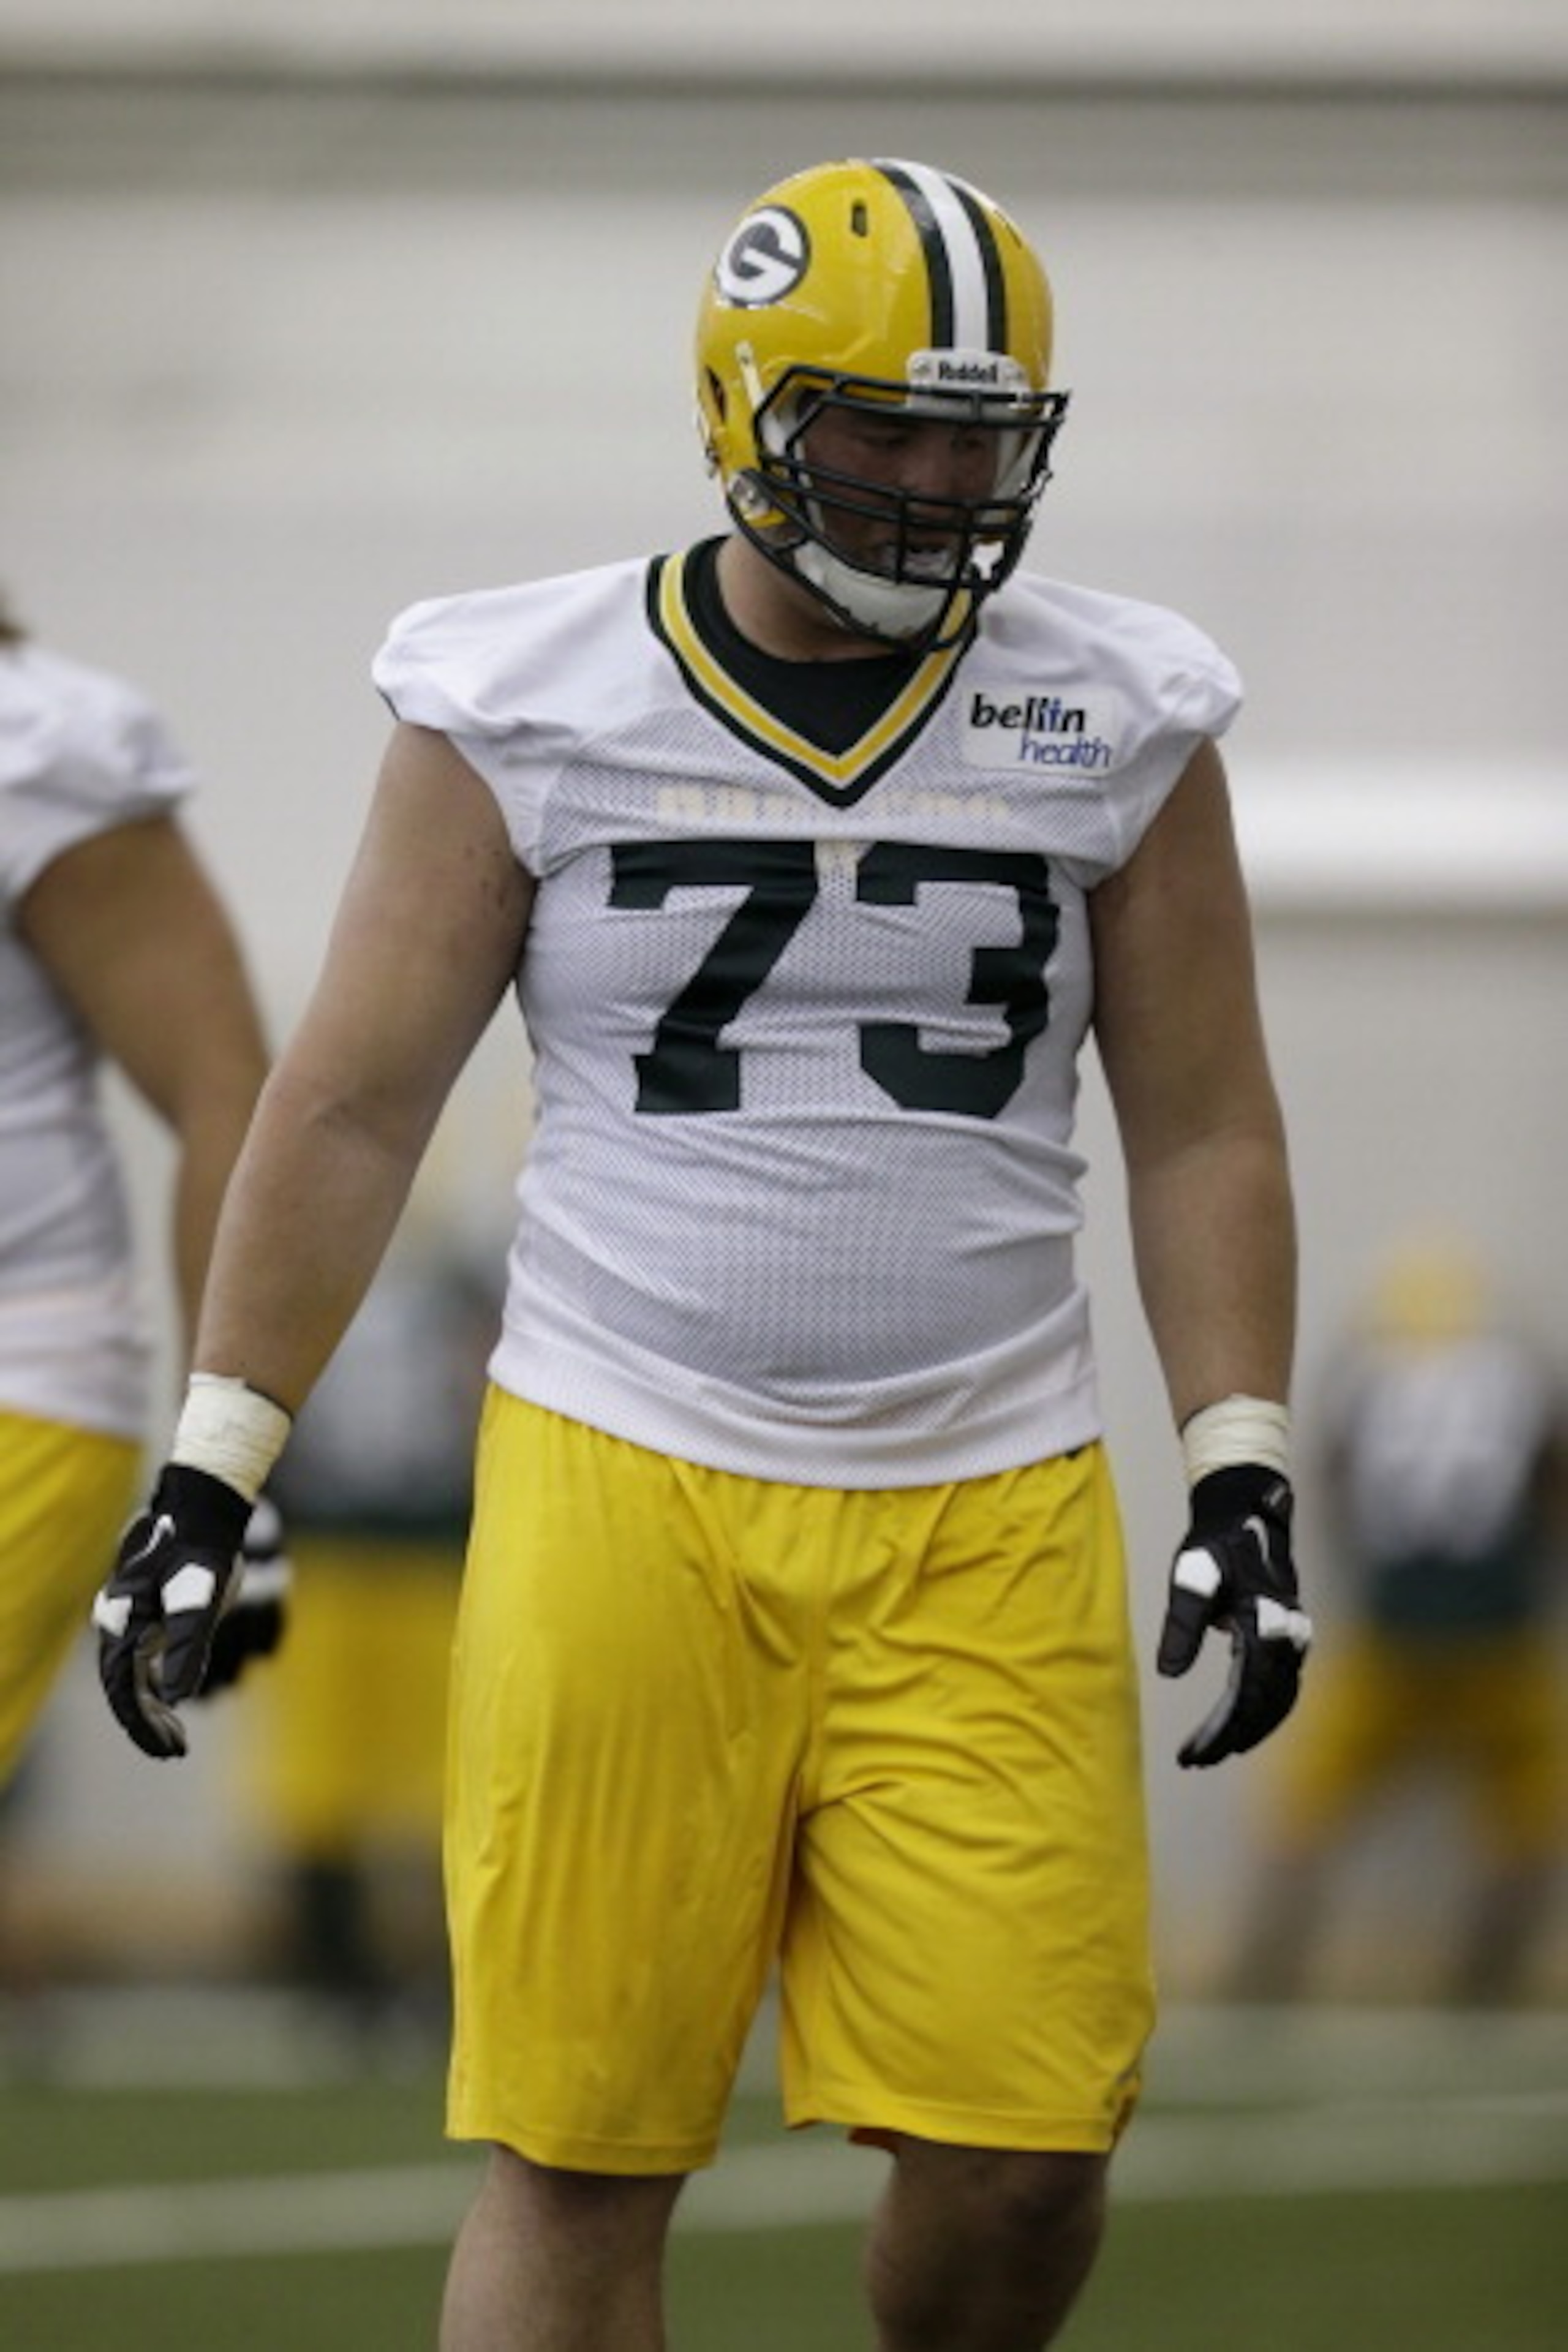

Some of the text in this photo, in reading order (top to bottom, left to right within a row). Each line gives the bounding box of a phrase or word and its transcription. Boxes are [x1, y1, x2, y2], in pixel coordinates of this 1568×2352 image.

[938, 360, 998, 384] Riddell
[971, 692, 1085, 733] bellin
[1019, 733, 1112, 768] health
[606, 839, 1060, 1119] 73
